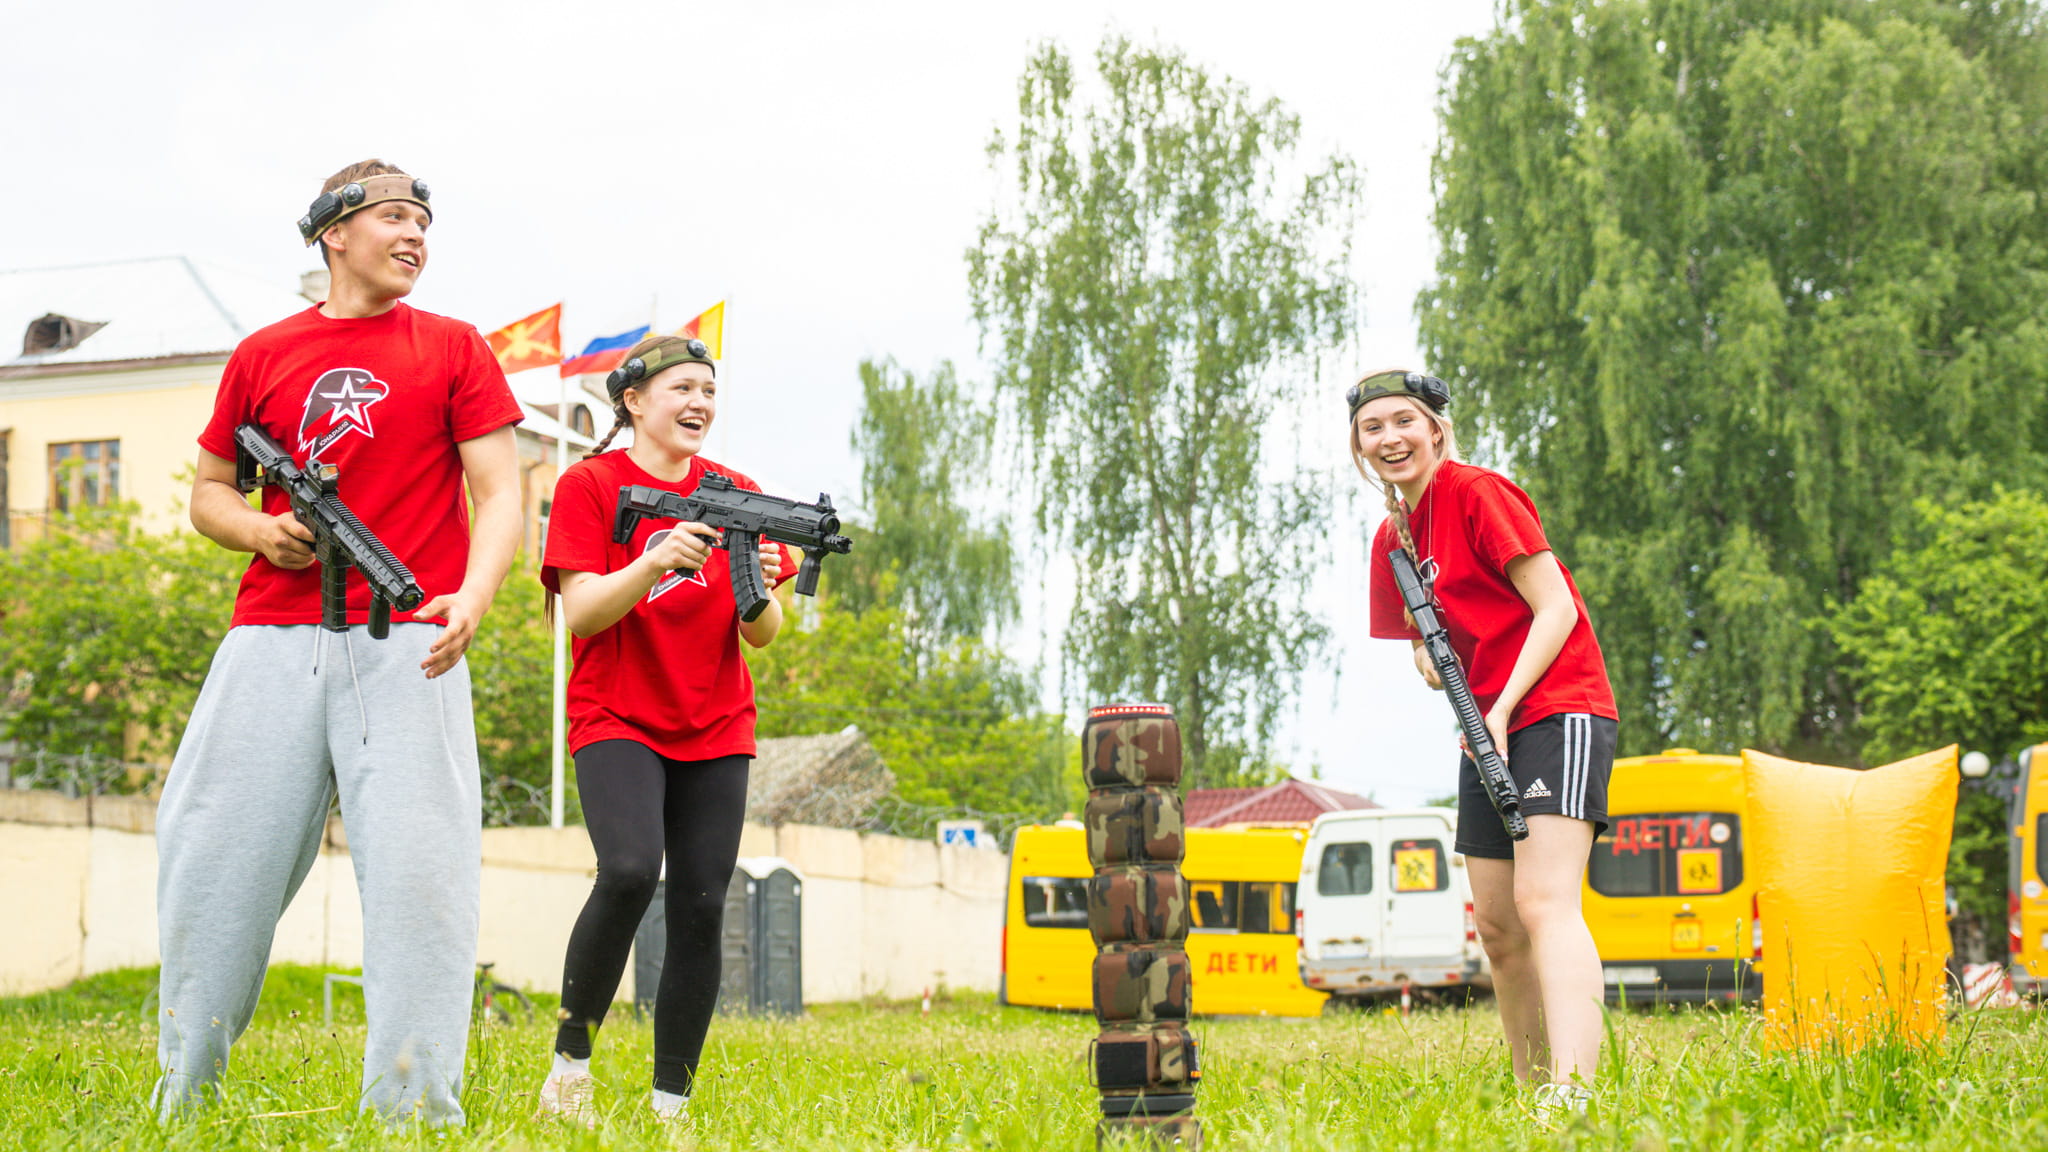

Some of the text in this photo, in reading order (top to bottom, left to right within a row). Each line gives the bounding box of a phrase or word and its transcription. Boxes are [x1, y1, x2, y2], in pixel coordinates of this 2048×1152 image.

[1523, 790, 1552, 800] adidas
[1612, 818, 1710, 856] ДЕТИ
[1205, 951, 1277, 976] ДЕТИ
